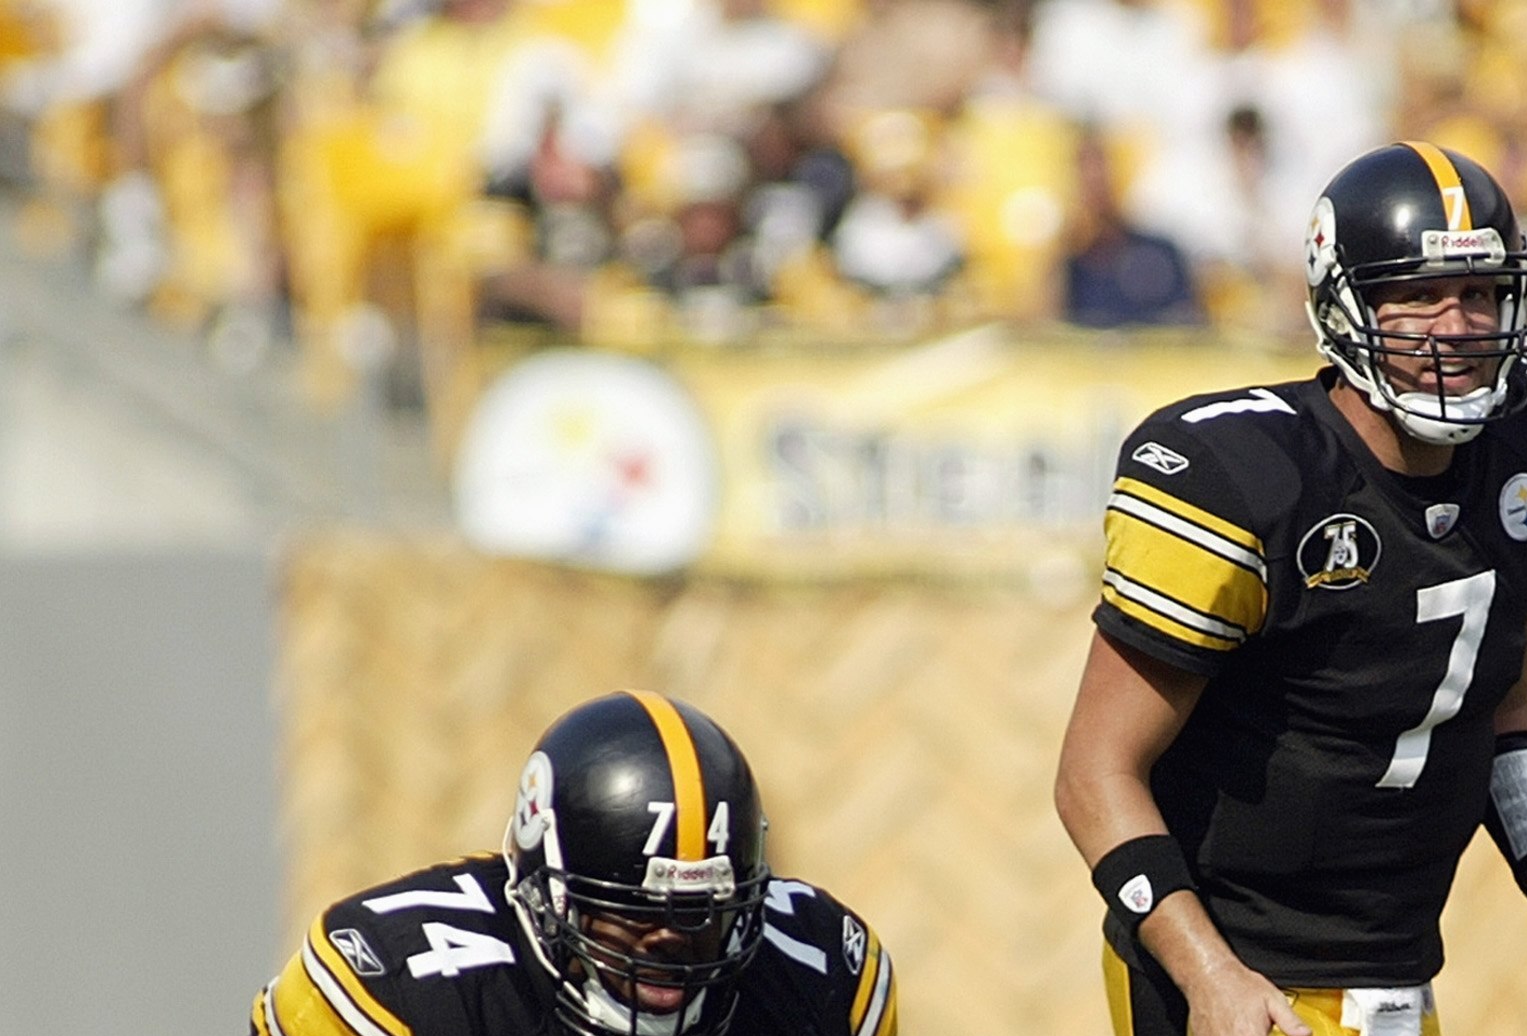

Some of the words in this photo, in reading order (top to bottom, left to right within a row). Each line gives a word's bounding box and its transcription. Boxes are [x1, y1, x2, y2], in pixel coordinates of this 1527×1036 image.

[1440, 185, 1465, 231] 7
[1375, 569, 1496, 789] 7
[361, 873, 516, 979] 74
